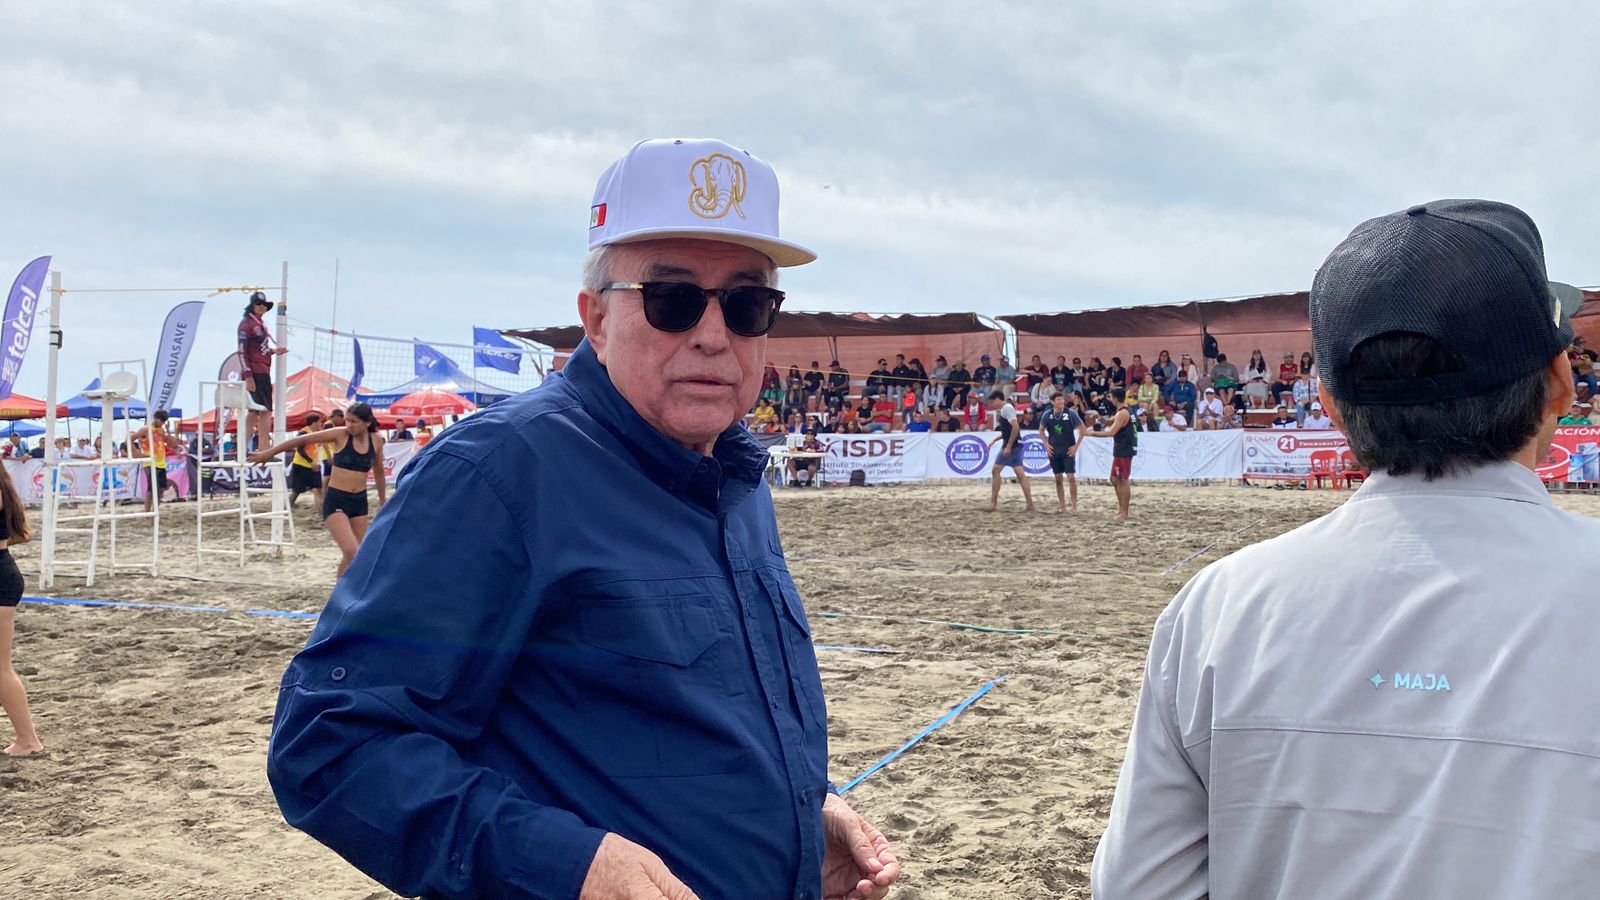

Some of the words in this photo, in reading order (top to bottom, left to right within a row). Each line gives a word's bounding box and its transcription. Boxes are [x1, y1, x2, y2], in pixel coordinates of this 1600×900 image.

[8, 285, 37, 359] telcel
[167, 322, 187, 377] GUASAVE
[1062, 412, 1069, 421] 2
[842, 439, 905, 458] ISDE
[1280, 437, 1295, 450] 21
[893, 459, 904, 467] de
[1394, 672, 1451, 691] MAJA
